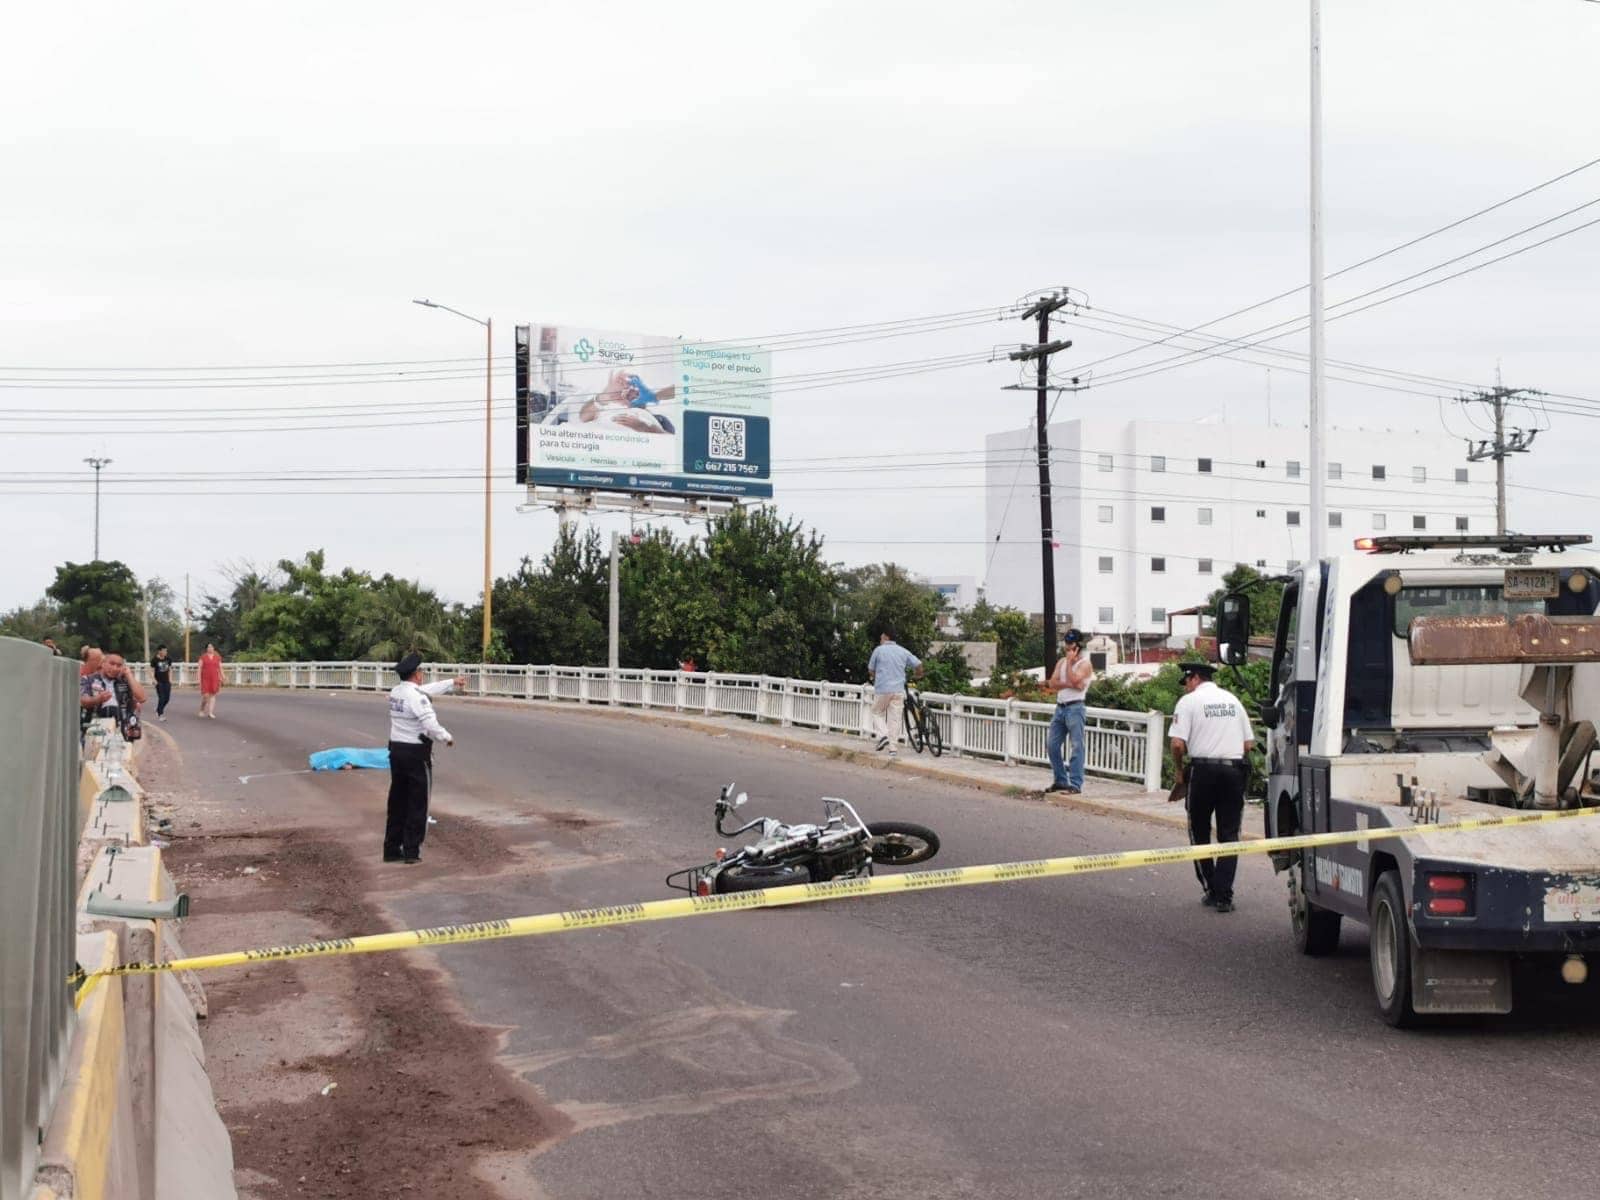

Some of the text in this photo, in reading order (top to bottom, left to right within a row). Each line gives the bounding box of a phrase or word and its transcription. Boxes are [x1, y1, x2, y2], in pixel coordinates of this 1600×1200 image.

[599, 349, 634, 361] Surgery
[742, 353, 751, 361] tu
[711, 362, 726, 371] por
[727, 363, 735, 371] el
[736, 364, 762, 374] precio
[539, 427, 557, 437] Una
[558, 429, 604, 441] alternativa
[539, 440, 559, 449] para
[560, 441, 570, 449] tu
[723, 463, 737, 472] 215
[737, 463, 759, 473] 7567
[1204, 709, 1236, 718] VIALIDAD
